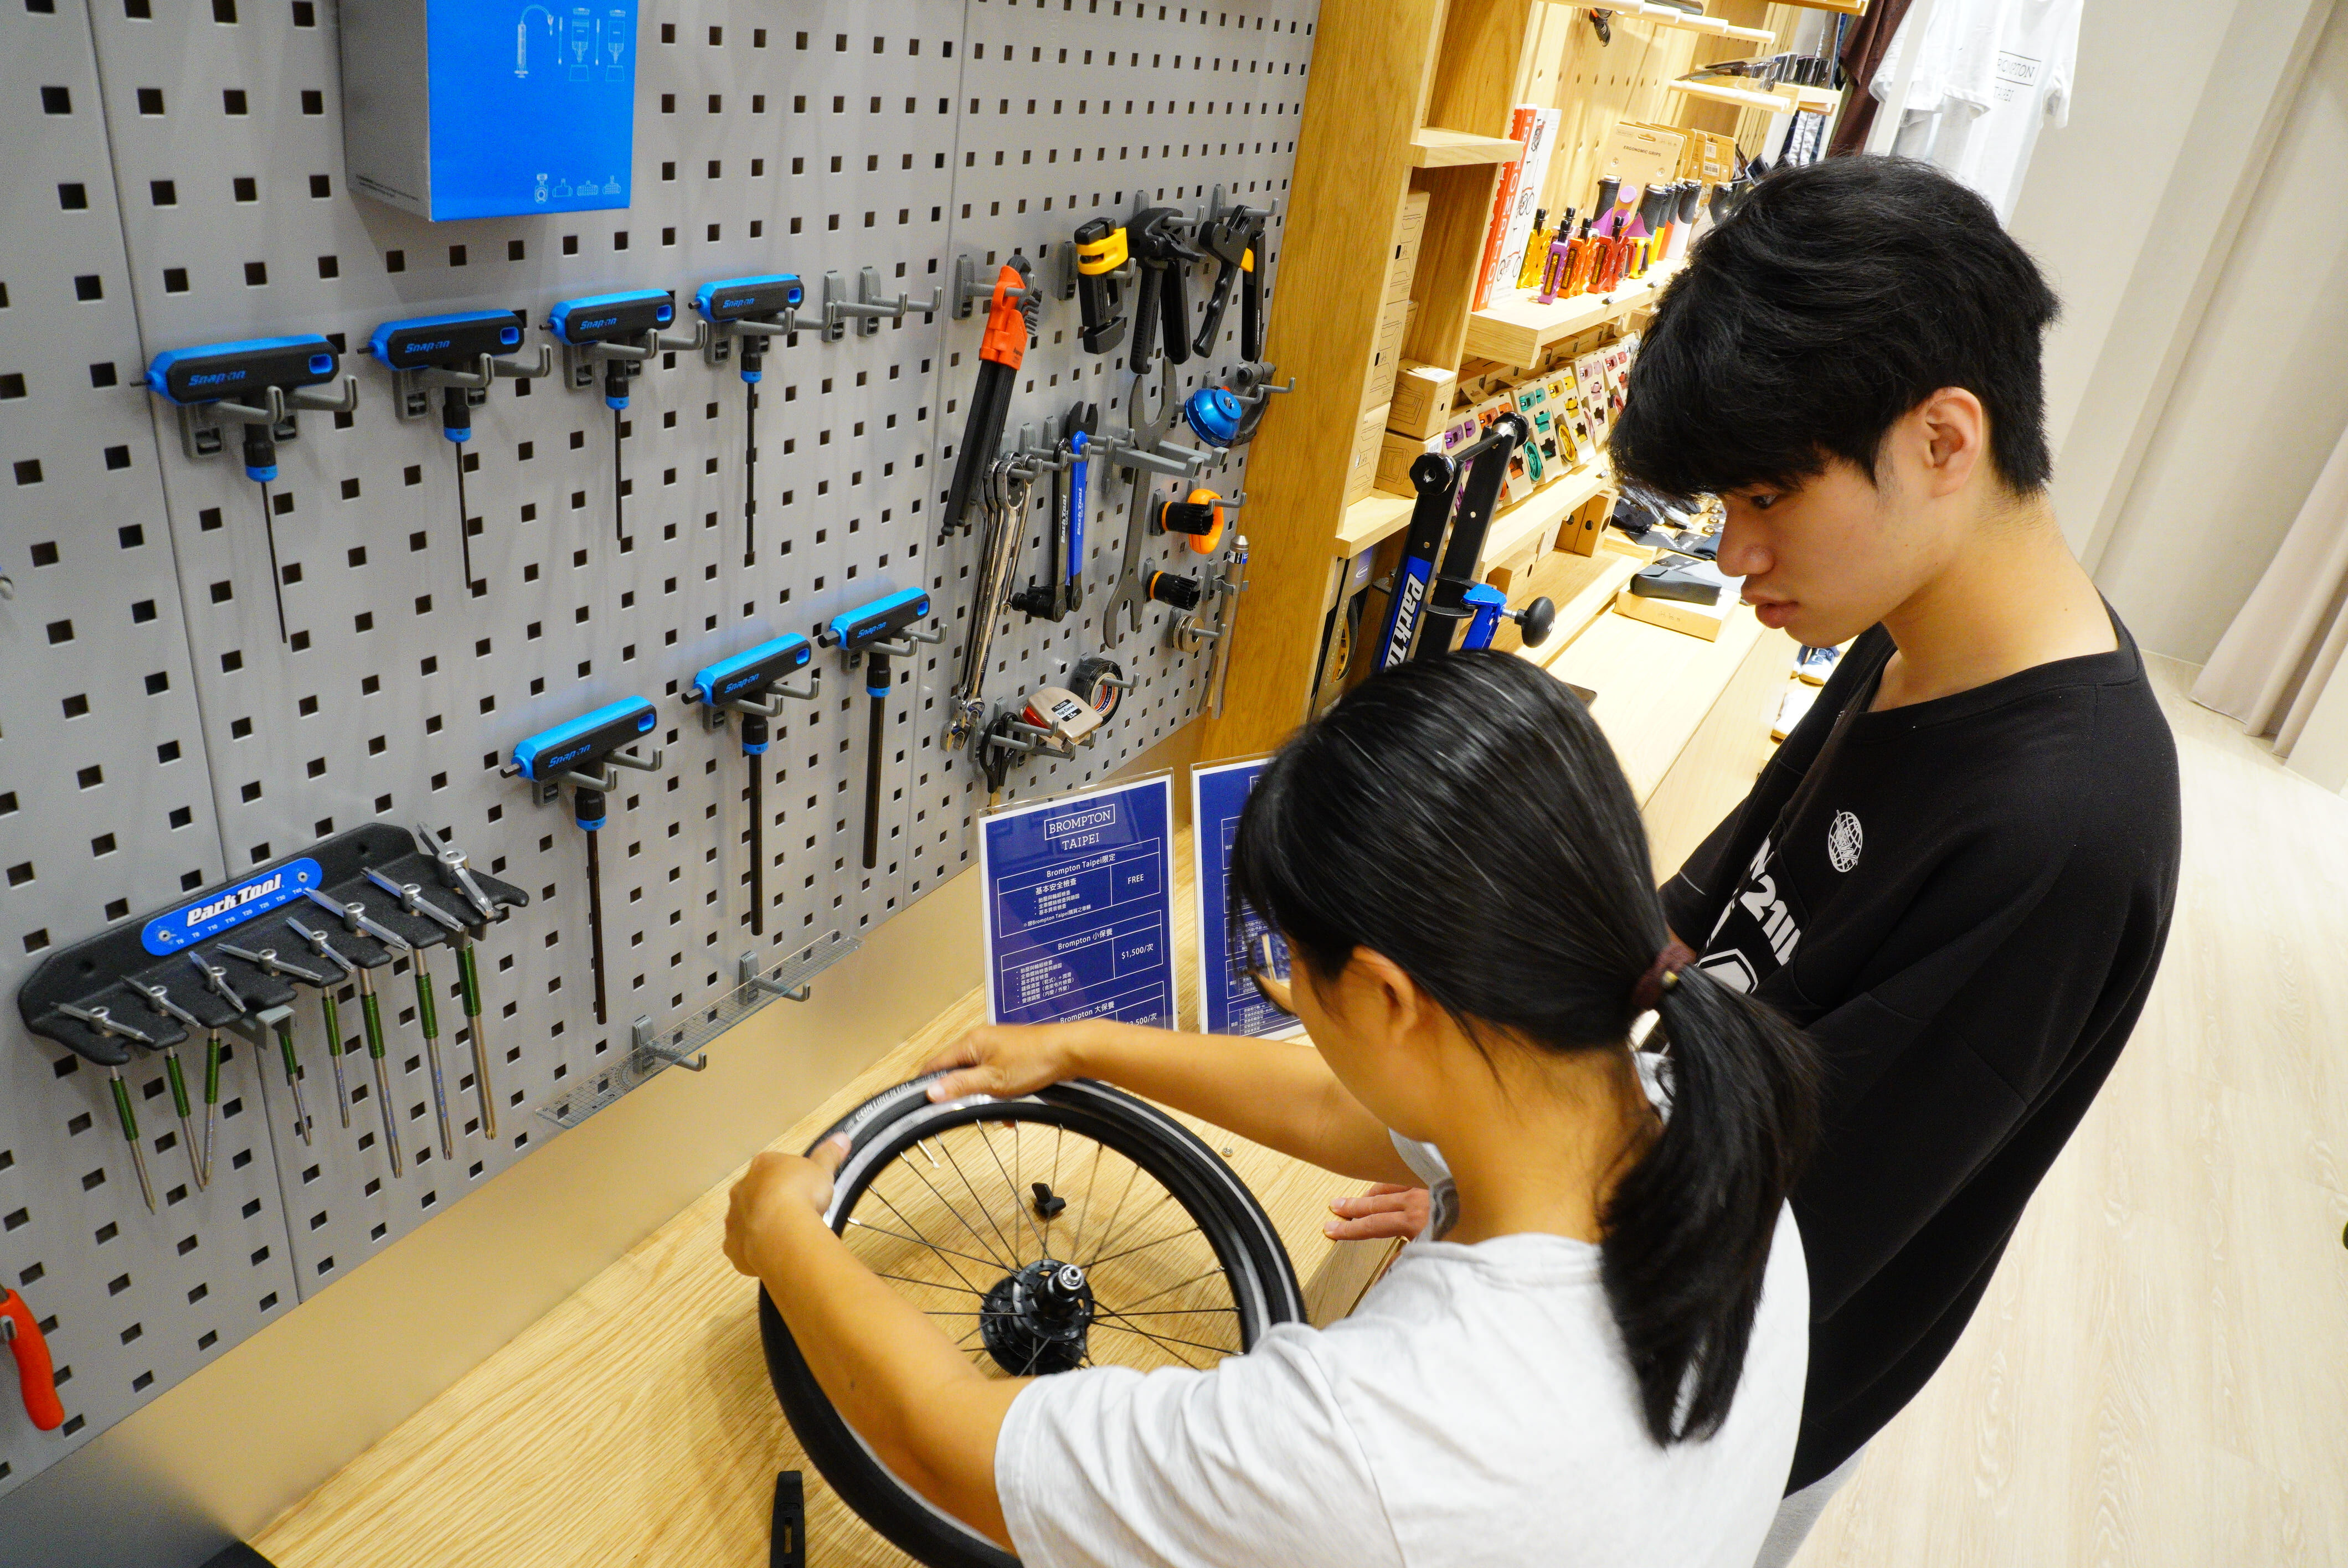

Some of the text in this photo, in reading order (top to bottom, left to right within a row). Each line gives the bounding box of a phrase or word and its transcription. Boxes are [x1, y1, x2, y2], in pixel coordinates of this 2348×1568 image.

[1623, 145, 1648, 154] ERGONOMIC
[1048, 809, 1111, 834] BROMPTON
[1062, 832, 1100, 850] TAIPEI
[1046, 853, 1116, 878] Brompton Taipei限定
[1035, 878, 1077, 895] 基本安全檢查
[1127, 874, 1144, 885] FREE
[187, 873, 282, 927] Park Tool
[208, 924, 218, 932] T10
[242, 909, 253, 917] T20
[276, 894, 286, 902] T30
[1058, 927, 1113, 951] Brompton 小保養
[1121, 943, 1154, 960] $1,500/次
[1060, 1001, 1115, 1024] Brompton 大保養
[856, 1082, 911, 1122] CONTINENTAL
